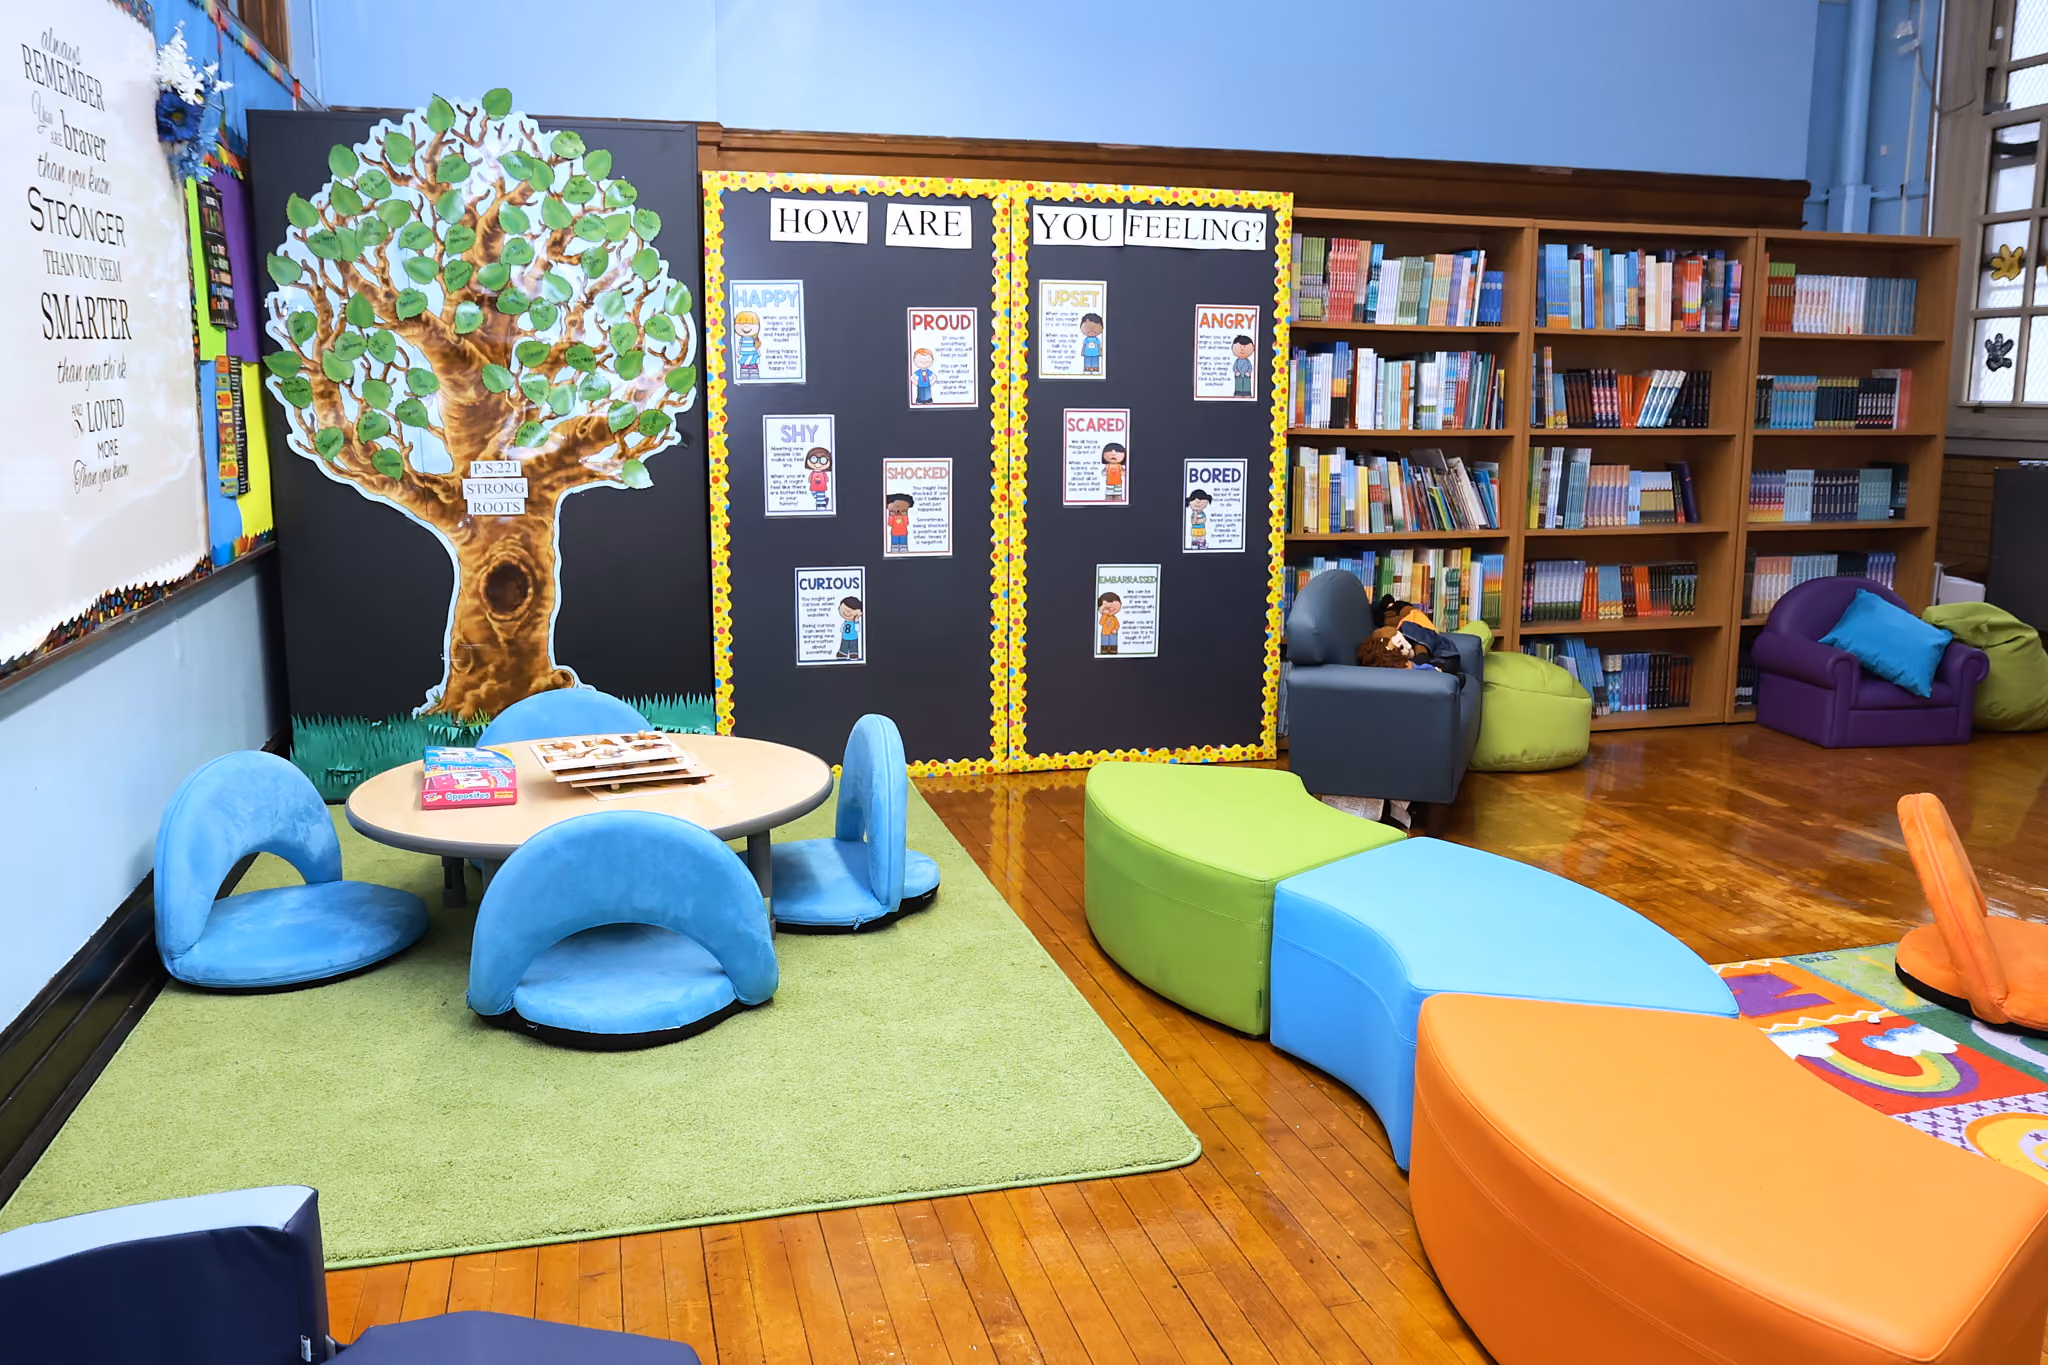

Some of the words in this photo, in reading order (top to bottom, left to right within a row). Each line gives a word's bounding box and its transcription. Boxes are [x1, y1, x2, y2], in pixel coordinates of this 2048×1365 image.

[21, 43, 105, 112] REMEMBER
[60, 108, 107, 163] braver
[37, 151, 65, 183] than
[68, 169, 86, 197] you
[27, 186, 126, 248] STRONGER
[778, 207, 862, 235] HOW
[891, 209, 963, 237] ARE
[1036, 212, 1113, 241] YOU
[1127, 214, 1265, 244] FEELING?
[43, 248, 74, 276] THAN
[75, 253, 97, 280] YOU
[98, 257, 122, 282] SEEM
[734, 288, 798, 308] HAPPY
[1048, 289, 1100, 307] UPSET
[41, 291, 133, 340] SMARTER
[912, 314, 972, 331] PROUD
[1199, 312, 1256, 329] ANGRY
[57, 355, 82, 384] than
[84, 363, 101, 392] you
[86, 398, 125, 433] LOVED
[1067, 417, 1125, 432] SCARED
[780, 424, 820, 443] SHY
[97, 438, 119, 460] MORE
[887, 466, 949, 480] SHOCKED
[1189, 467, 1242, 483] BORED
[466, 482, 525, 495] STRONG
[473, 501, 521, 513] ROOTS
[799, 577, 860, 590] CURIOUS
[1098, 575, 1158, 584] EMBARRASSED
[844, 623, 852, 634] 8
[445, 790, 491, 802] Opposites
